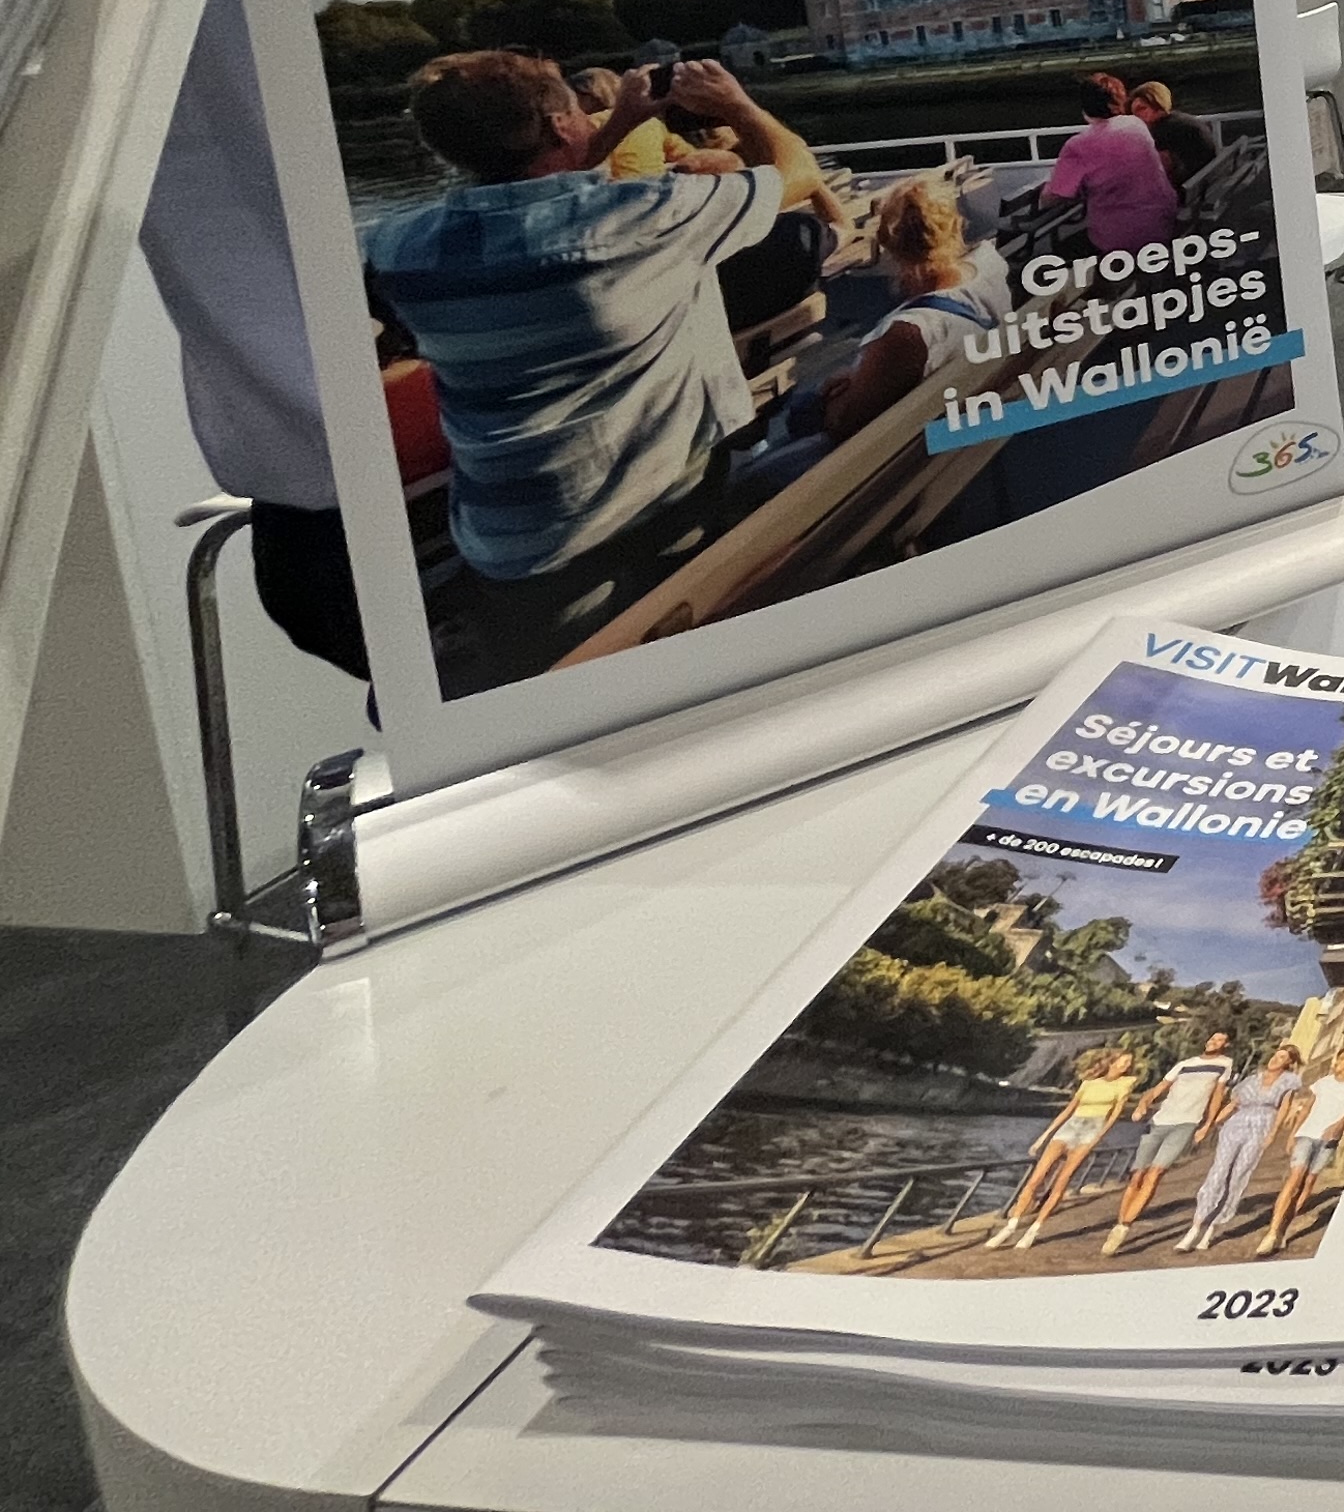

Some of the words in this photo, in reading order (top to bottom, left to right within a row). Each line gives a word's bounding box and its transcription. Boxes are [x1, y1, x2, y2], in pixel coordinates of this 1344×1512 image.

[1021, 226, 1261, 295] Groeps-
[963, 269, 1267, 364] uitstapjes
[944, 389, 1003, 433] in
[1018, 313, 1272, 411] Wallonië
[1075, 713, 1258, 768] Séjours
[1268, 749, 1320, 774] et
[1046, 749, 1315, 808] excursions
[1015, 780, 1083, 812] en
[1091, 791, 1310, 843] Wallonie
[999, 835, 1022, 847] de
[1023, 839, 1060, 853] 200
[1198, 1288, 1299, 1320] 2023
